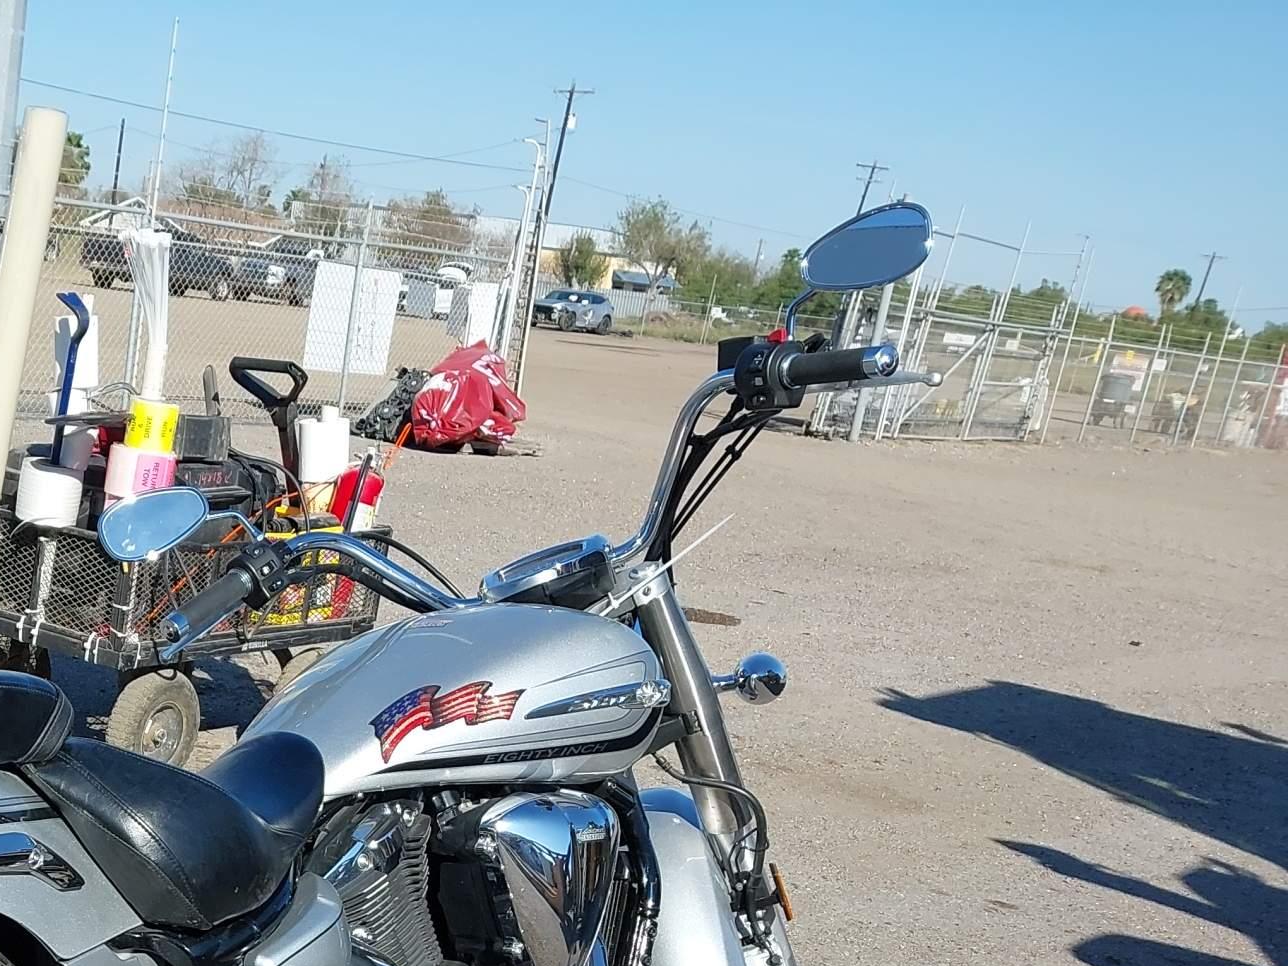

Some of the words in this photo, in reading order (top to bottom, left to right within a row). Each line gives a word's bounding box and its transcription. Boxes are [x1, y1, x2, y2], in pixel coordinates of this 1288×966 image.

[142, 468, 150, 487] TOW
[151, 462, 160, 489] RETUR
[483, 748, 558, 764] EIGHTY
[559, 742, 609, 757] INCH
